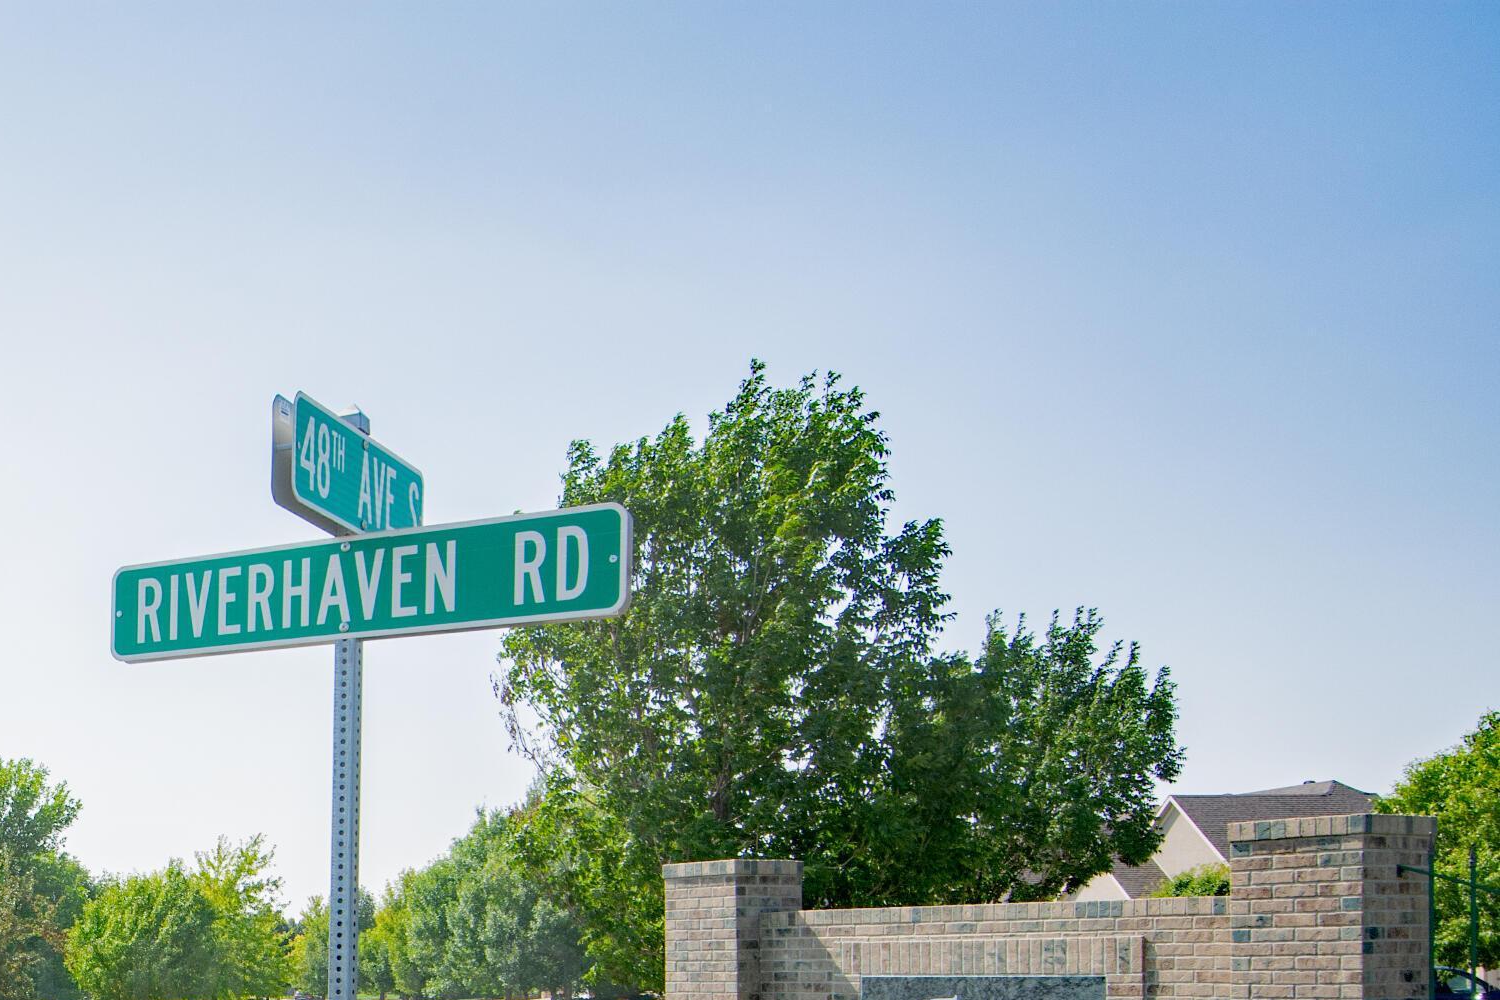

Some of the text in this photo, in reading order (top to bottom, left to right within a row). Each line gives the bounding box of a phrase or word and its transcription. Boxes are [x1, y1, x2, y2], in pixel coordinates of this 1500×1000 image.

[300, 415, 345, 499] 48TH
[358, 450, 397, 530] AVE
[136, 525, 590, 644] RIVERHAVEN RD
